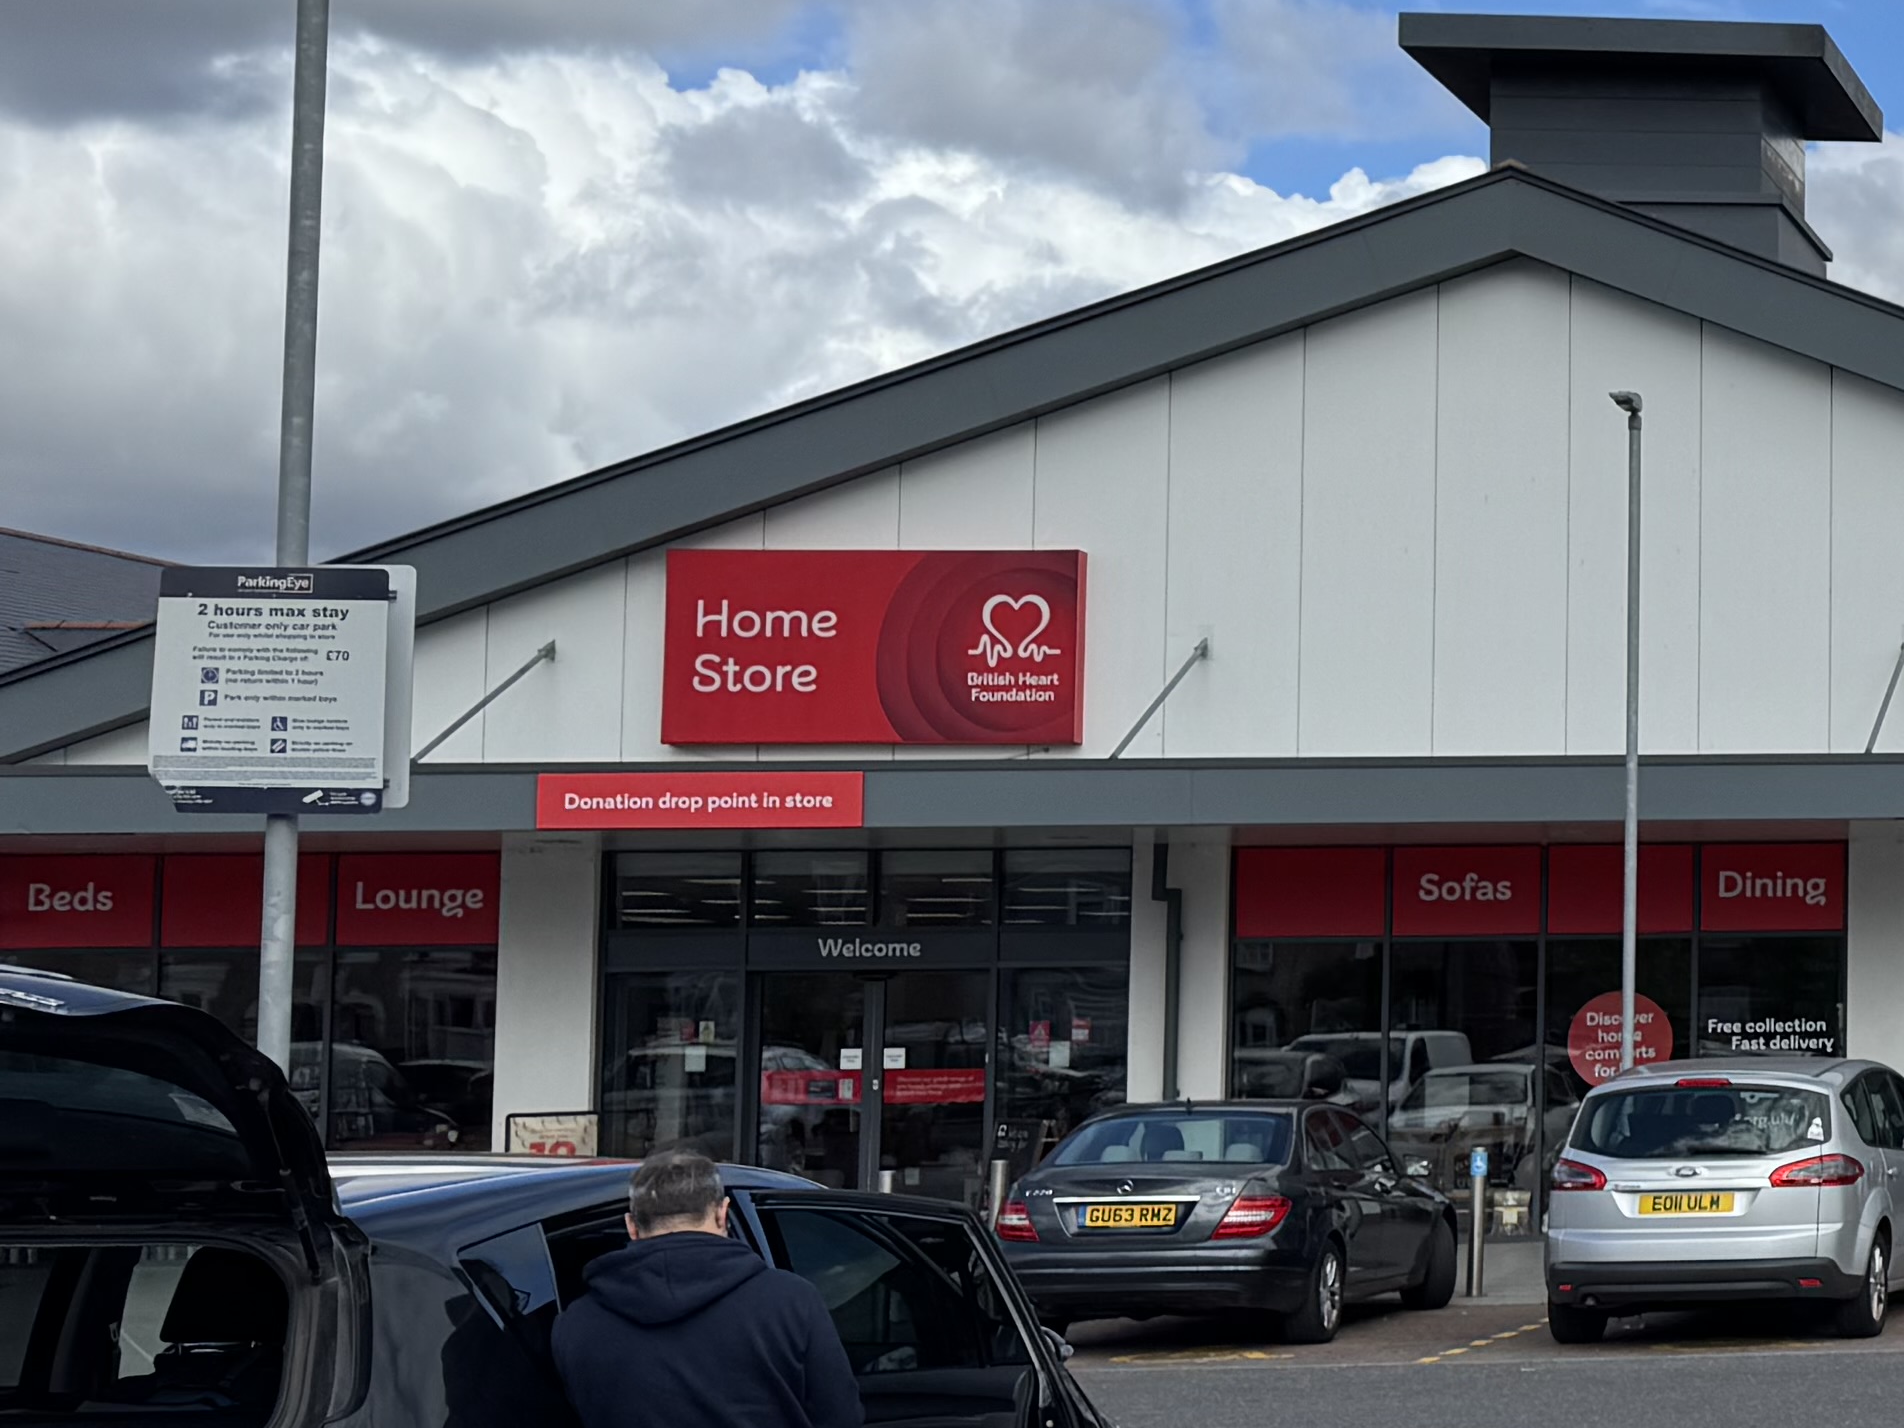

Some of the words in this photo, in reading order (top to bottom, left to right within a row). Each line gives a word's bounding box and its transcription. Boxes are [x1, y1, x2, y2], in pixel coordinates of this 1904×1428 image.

[237, 575, 309, 590] ParkingEye
[198, 603, 208, 616] 2
[213, 603, 263, 618] hours
[269, 606, 306, 618] max
[312, 606, 350, 621] stay
[696, 599, 838, 639] Home
[207, 621, 261, 631] Customer
[265, 622, 289, 632] only
[292, 623, 310, 632] car
[313, 623, 337, 632] park
[326, 650, 350, 661] £70
[692, 654, 818, 693] Store
[967, 673, 1015, 686] British
[1018, 673, 1059, 686] Heart
[971, 689, 1055, 702] Foundation
[564, 793, 654, 810] Donation
[658, 792, 702, 813] drop
[708, 792, 758, 812] point
[763, 792, 780, 808] in
[785, 792, 833, 808] store
[1418, 873, 1512, 902] Sofas
[1718, 871, 1826, 906] Dining
[28, 884, 113, 911] Beds
[356, 882, 484, 918] Lounge
[818, 938, 921, 958] Welcome
[1586, 1012, 1654, 1026] Discver
[1707, 1020, 1741, 1033] Free
[1745, 1019, 1827, 1033] collection
[1731, 1037, 1766, 1050] Fast
[1770, 1037, 1834, 1052] delivery
[1089, 1207, 1135, 1223] GU63
[1139, 1205, 1175, 1222] RMZ
